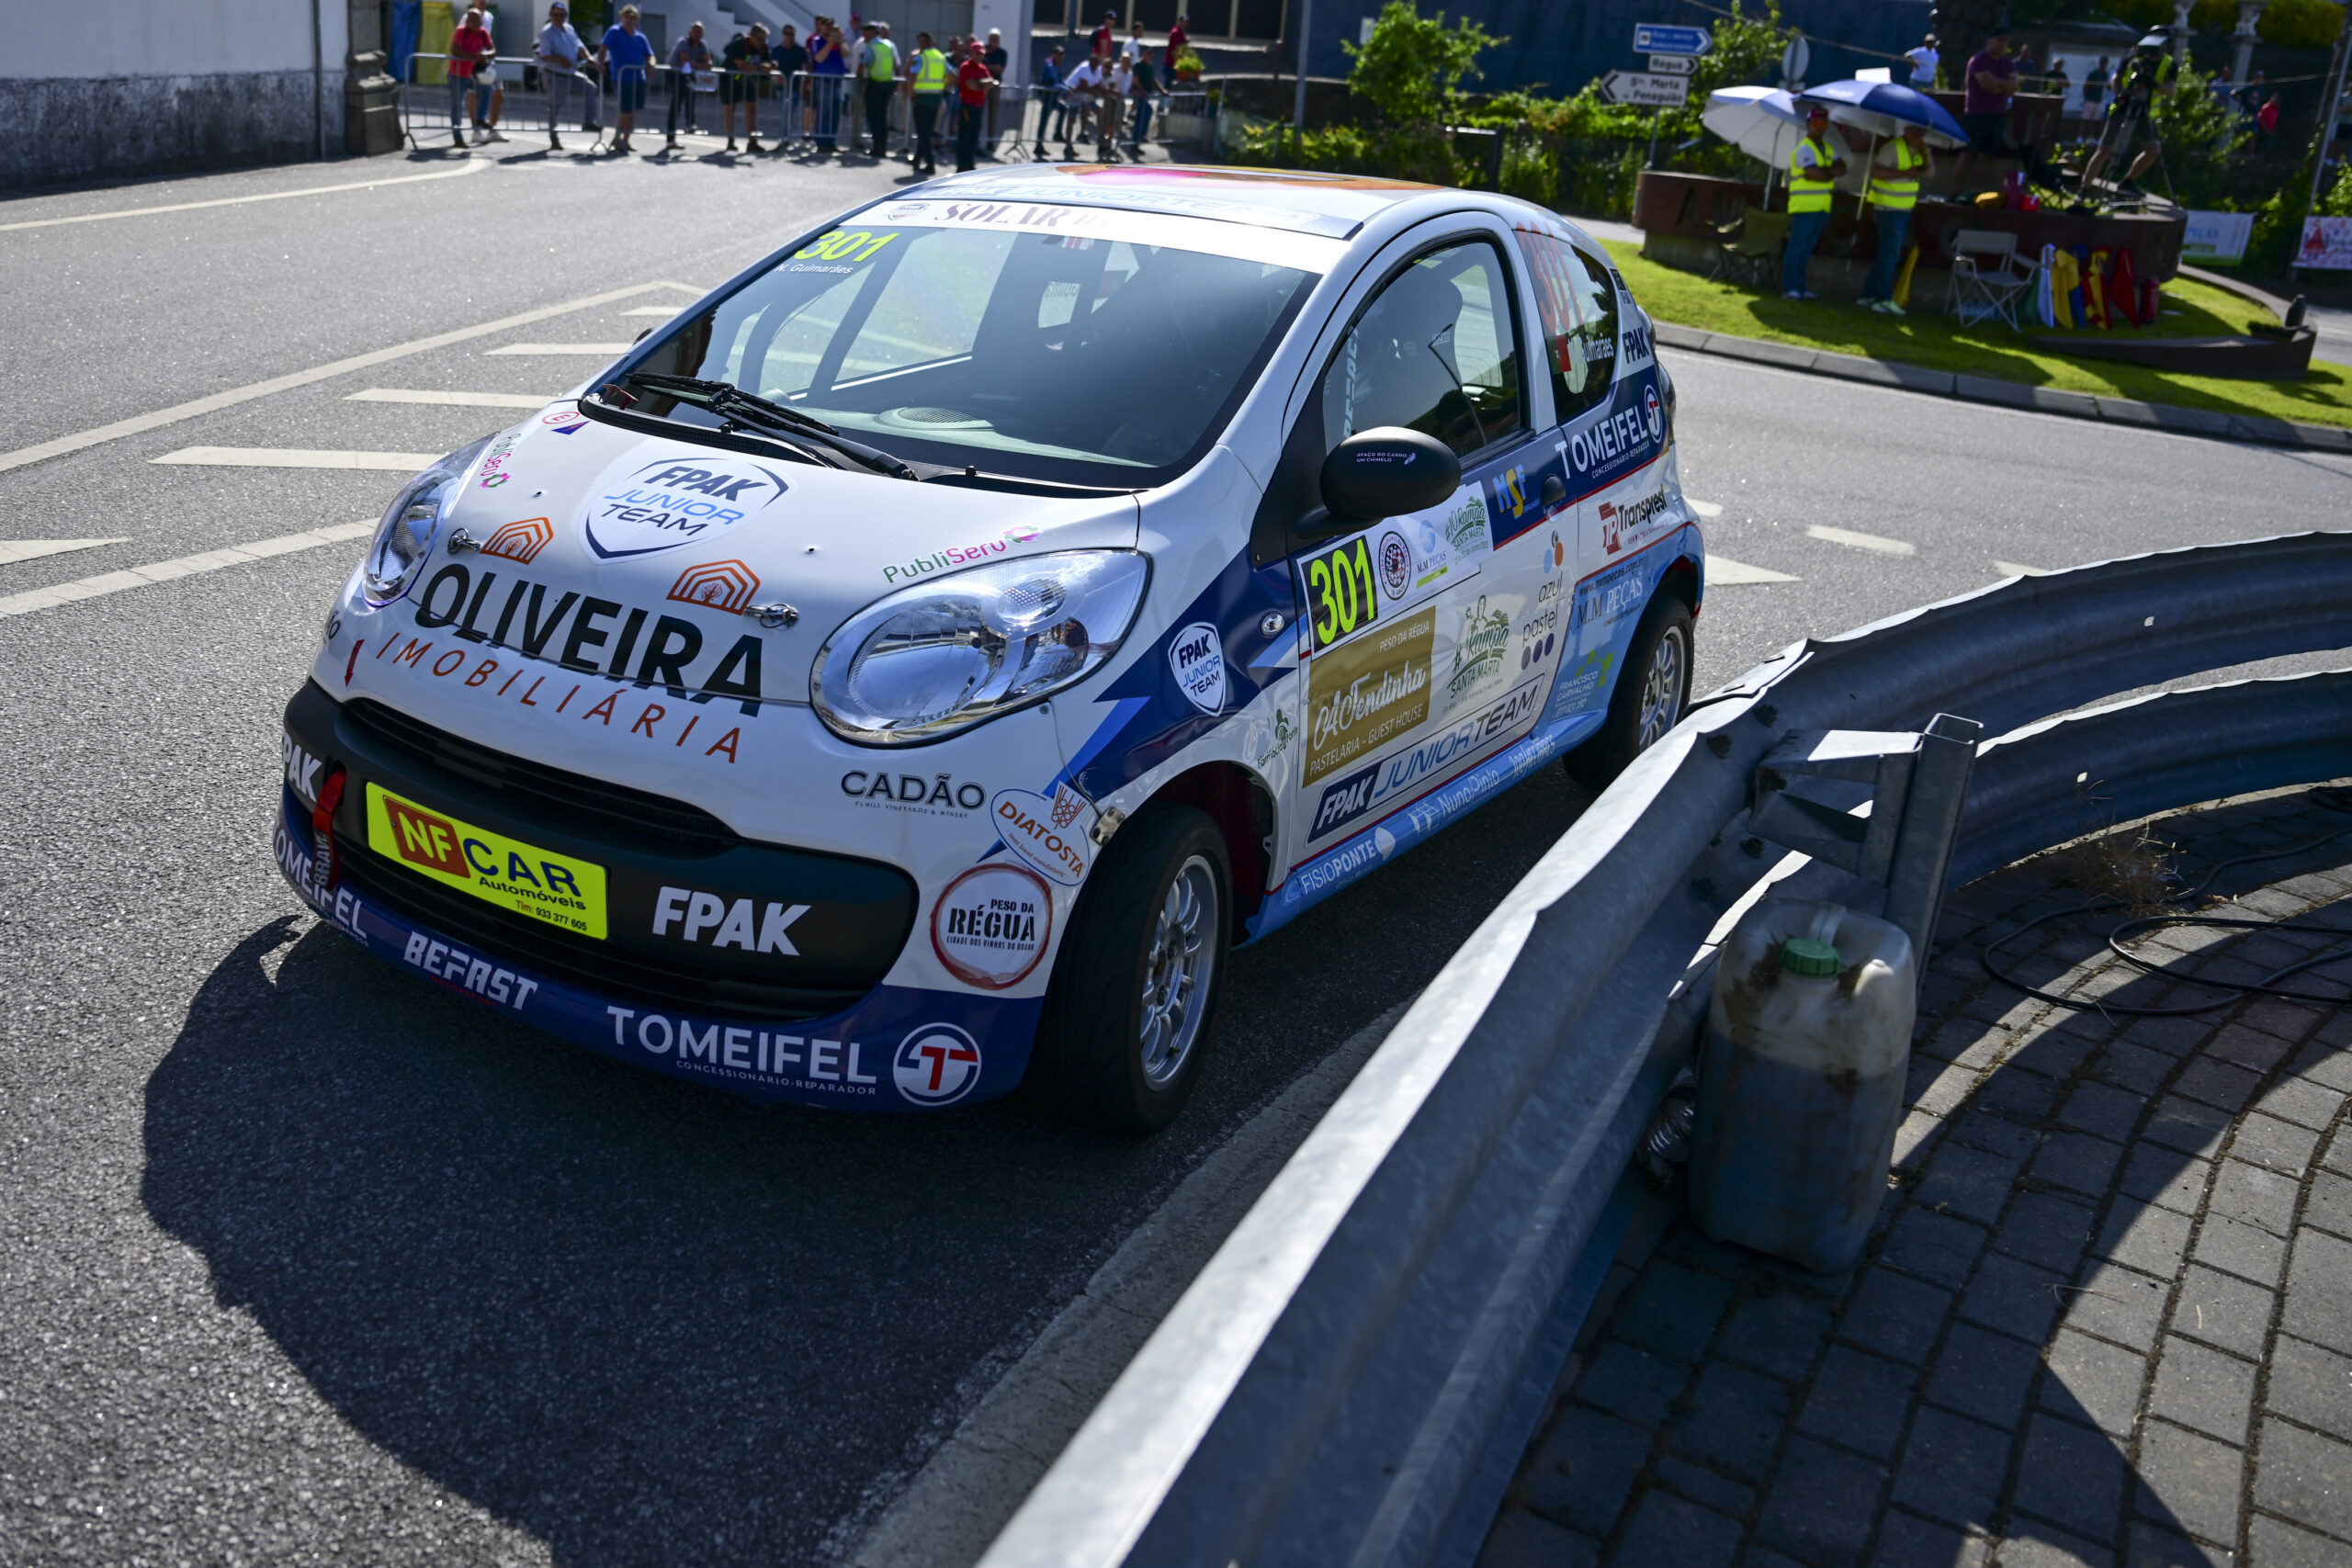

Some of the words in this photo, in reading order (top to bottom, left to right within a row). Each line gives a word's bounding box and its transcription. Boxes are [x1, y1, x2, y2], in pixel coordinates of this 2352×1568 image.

[1650, 77, 1679, 90] Marta
[933, 203, 1072, 228] SOLAR
[794, 231, 899, 262] 301
[789, 264, 854, 275] Guimarães
[1516, 220, 1584, 334] 301
[1622, 326, 1650, 365] FPAK
[1554, 405, 1648, 480] TOMEIFEL
[643, 466, 770, 502] FPAK
[1492, 463, 1527, 520] NSF
[601, 503, 709, 536] TEAM
[603, 489, 746, 525] JUNIOR
[1618, 489, 1668, 533] Transprest
[1453, 532, 1469, 551] SANTA
[1469, 526, 1485, 538] MARTA
[882, 539, 1008, 584] PubliServ
[1310, 538, 1375, 645] 301
[1538, 571, 1563, 604] azul
[1605, 575, 1644, 615] PEÇAS
[414, 563, 763, 718] OLIVEIRA
[1379, 634, 1396, 653] PESO
[1396, 631, 1408, 645] DA
[1408, 620, 1430, 640] RÉGUA
[1521, 603, 1559, 649] pastel
[1178, 633, 1212, 670] FPAK
[1182, 654, 1221, 688] JUNIOR
[377, 631, 741, 764] IMOBILIÁRIA
[1190, 671, 1221, 698] TEAM
[1450, 670, 1476, 699] SANTA
[1476, 659, 1500, 681] MARTA
[1309, 737, 1360, 776] PASTELARIA
[1368, 717, 1396, 744] GUEST
[1396, 703, 1424, 728] HOUSE
[281, 731, 322, 803] PAK
[840, 769, 987, 810] CADÃO
[1316, 773, 1376, 831] FPAK
[940, 810, 968, 819] WINERY
[998, 800, 1086, 878] DIATOSTA
[462, 837, 582, 897] CAR
[1300, 839, 1376, 896] FISIOPONTE
[479, 876, 587, 911] Automóveis
[990, 898, 1017, 912] PESO
[1021, 902, 1035, 914] DA
[515, 899, 535, 914] Tlm:
[536, 907, 552, 919] 933
[553, 912, 570, 925] 377
[571, 918, 588, 931] 605
[651, 886, 812, 957] FPAK
[947, 904, 1035, 942] RÉGUA
[945, 935, 968, 945] CIDADE
[969, 937, 981, 946] DOS
[983, 939, 1005, 950] VINHOS
[1007, 942, 1015, 951] DO
[1016, 942, 1035, 952] DOURO
[403, 930, 539, 1011] BEFAST
[606, 1005, 877, 1085] TOMEIFEL
